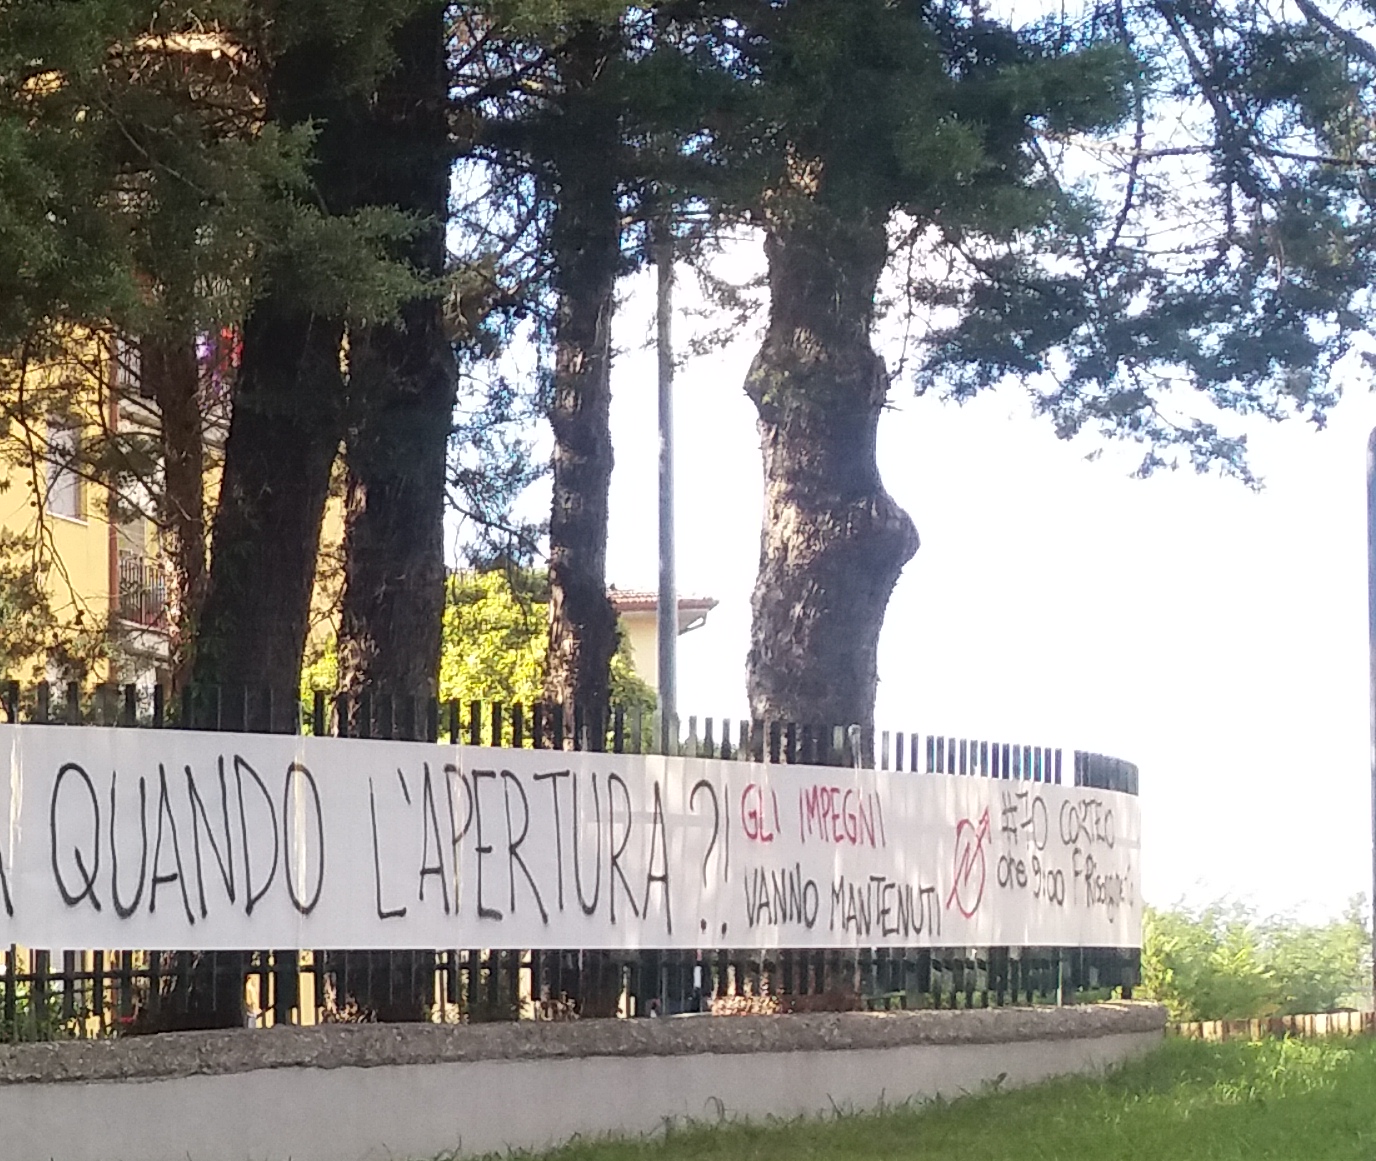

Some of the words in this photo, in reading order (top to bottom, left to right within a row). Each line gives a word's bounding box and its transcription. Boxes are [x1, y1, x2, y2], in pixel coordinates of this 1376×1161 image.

[50, 753, 326, 926] QUANDO
[740, 783, 781, 843] GLI
[798, 784, 887, 849] IMPEGNI
[1059, 798, 1115, 849] CORTEO
[744, 861, 820, 929] VANNO
[828, 874, 942, 938] MANTENUTI
[997, 852, 1028, 890] ore
